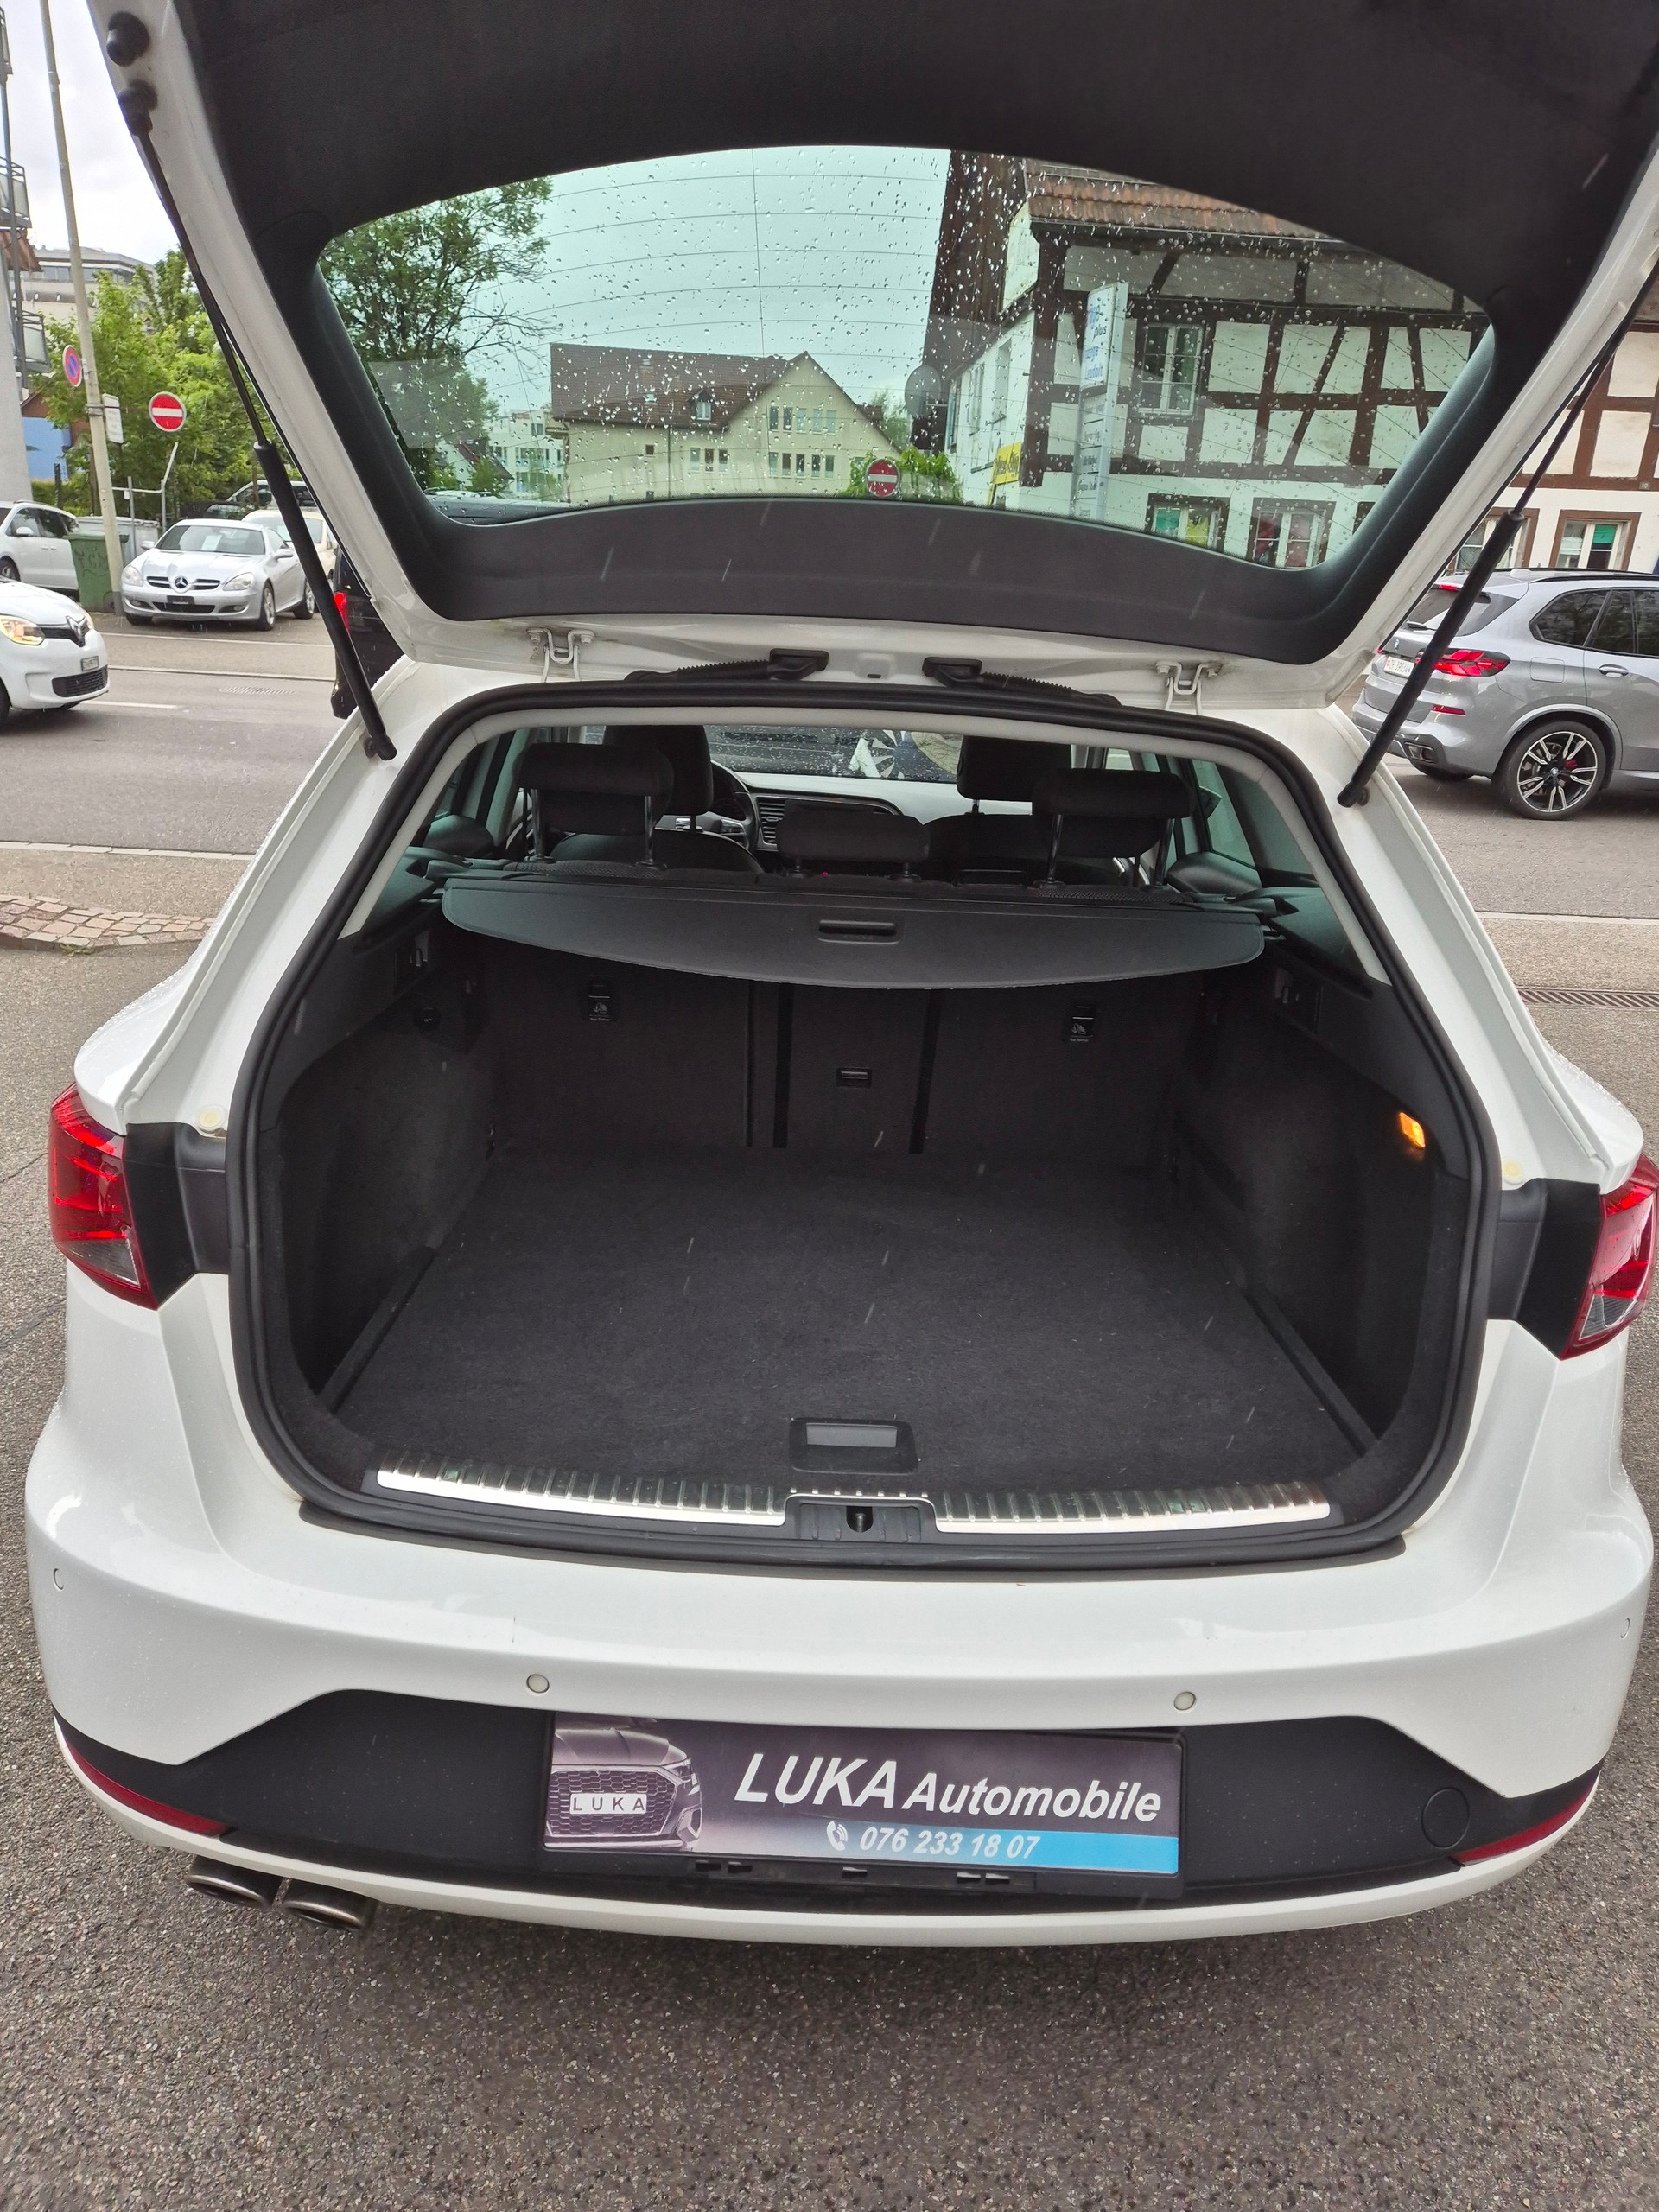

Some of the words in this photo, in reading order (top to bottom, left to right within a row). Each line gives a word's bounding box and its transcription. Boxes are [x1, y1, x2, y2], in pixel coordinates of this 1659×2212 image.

[734, 1753, 897, 1808] LUKA
[901, 1772, 1161, 1822] Automobile
[573, 1797, 645, 1811] LUKA
[860, 1827, 909, 1853] 076
[913, 1830, 963, 1855] 233
[971, 1834, 1001, 1858] 18
[1007, 1835, 1040, 1859] 07
